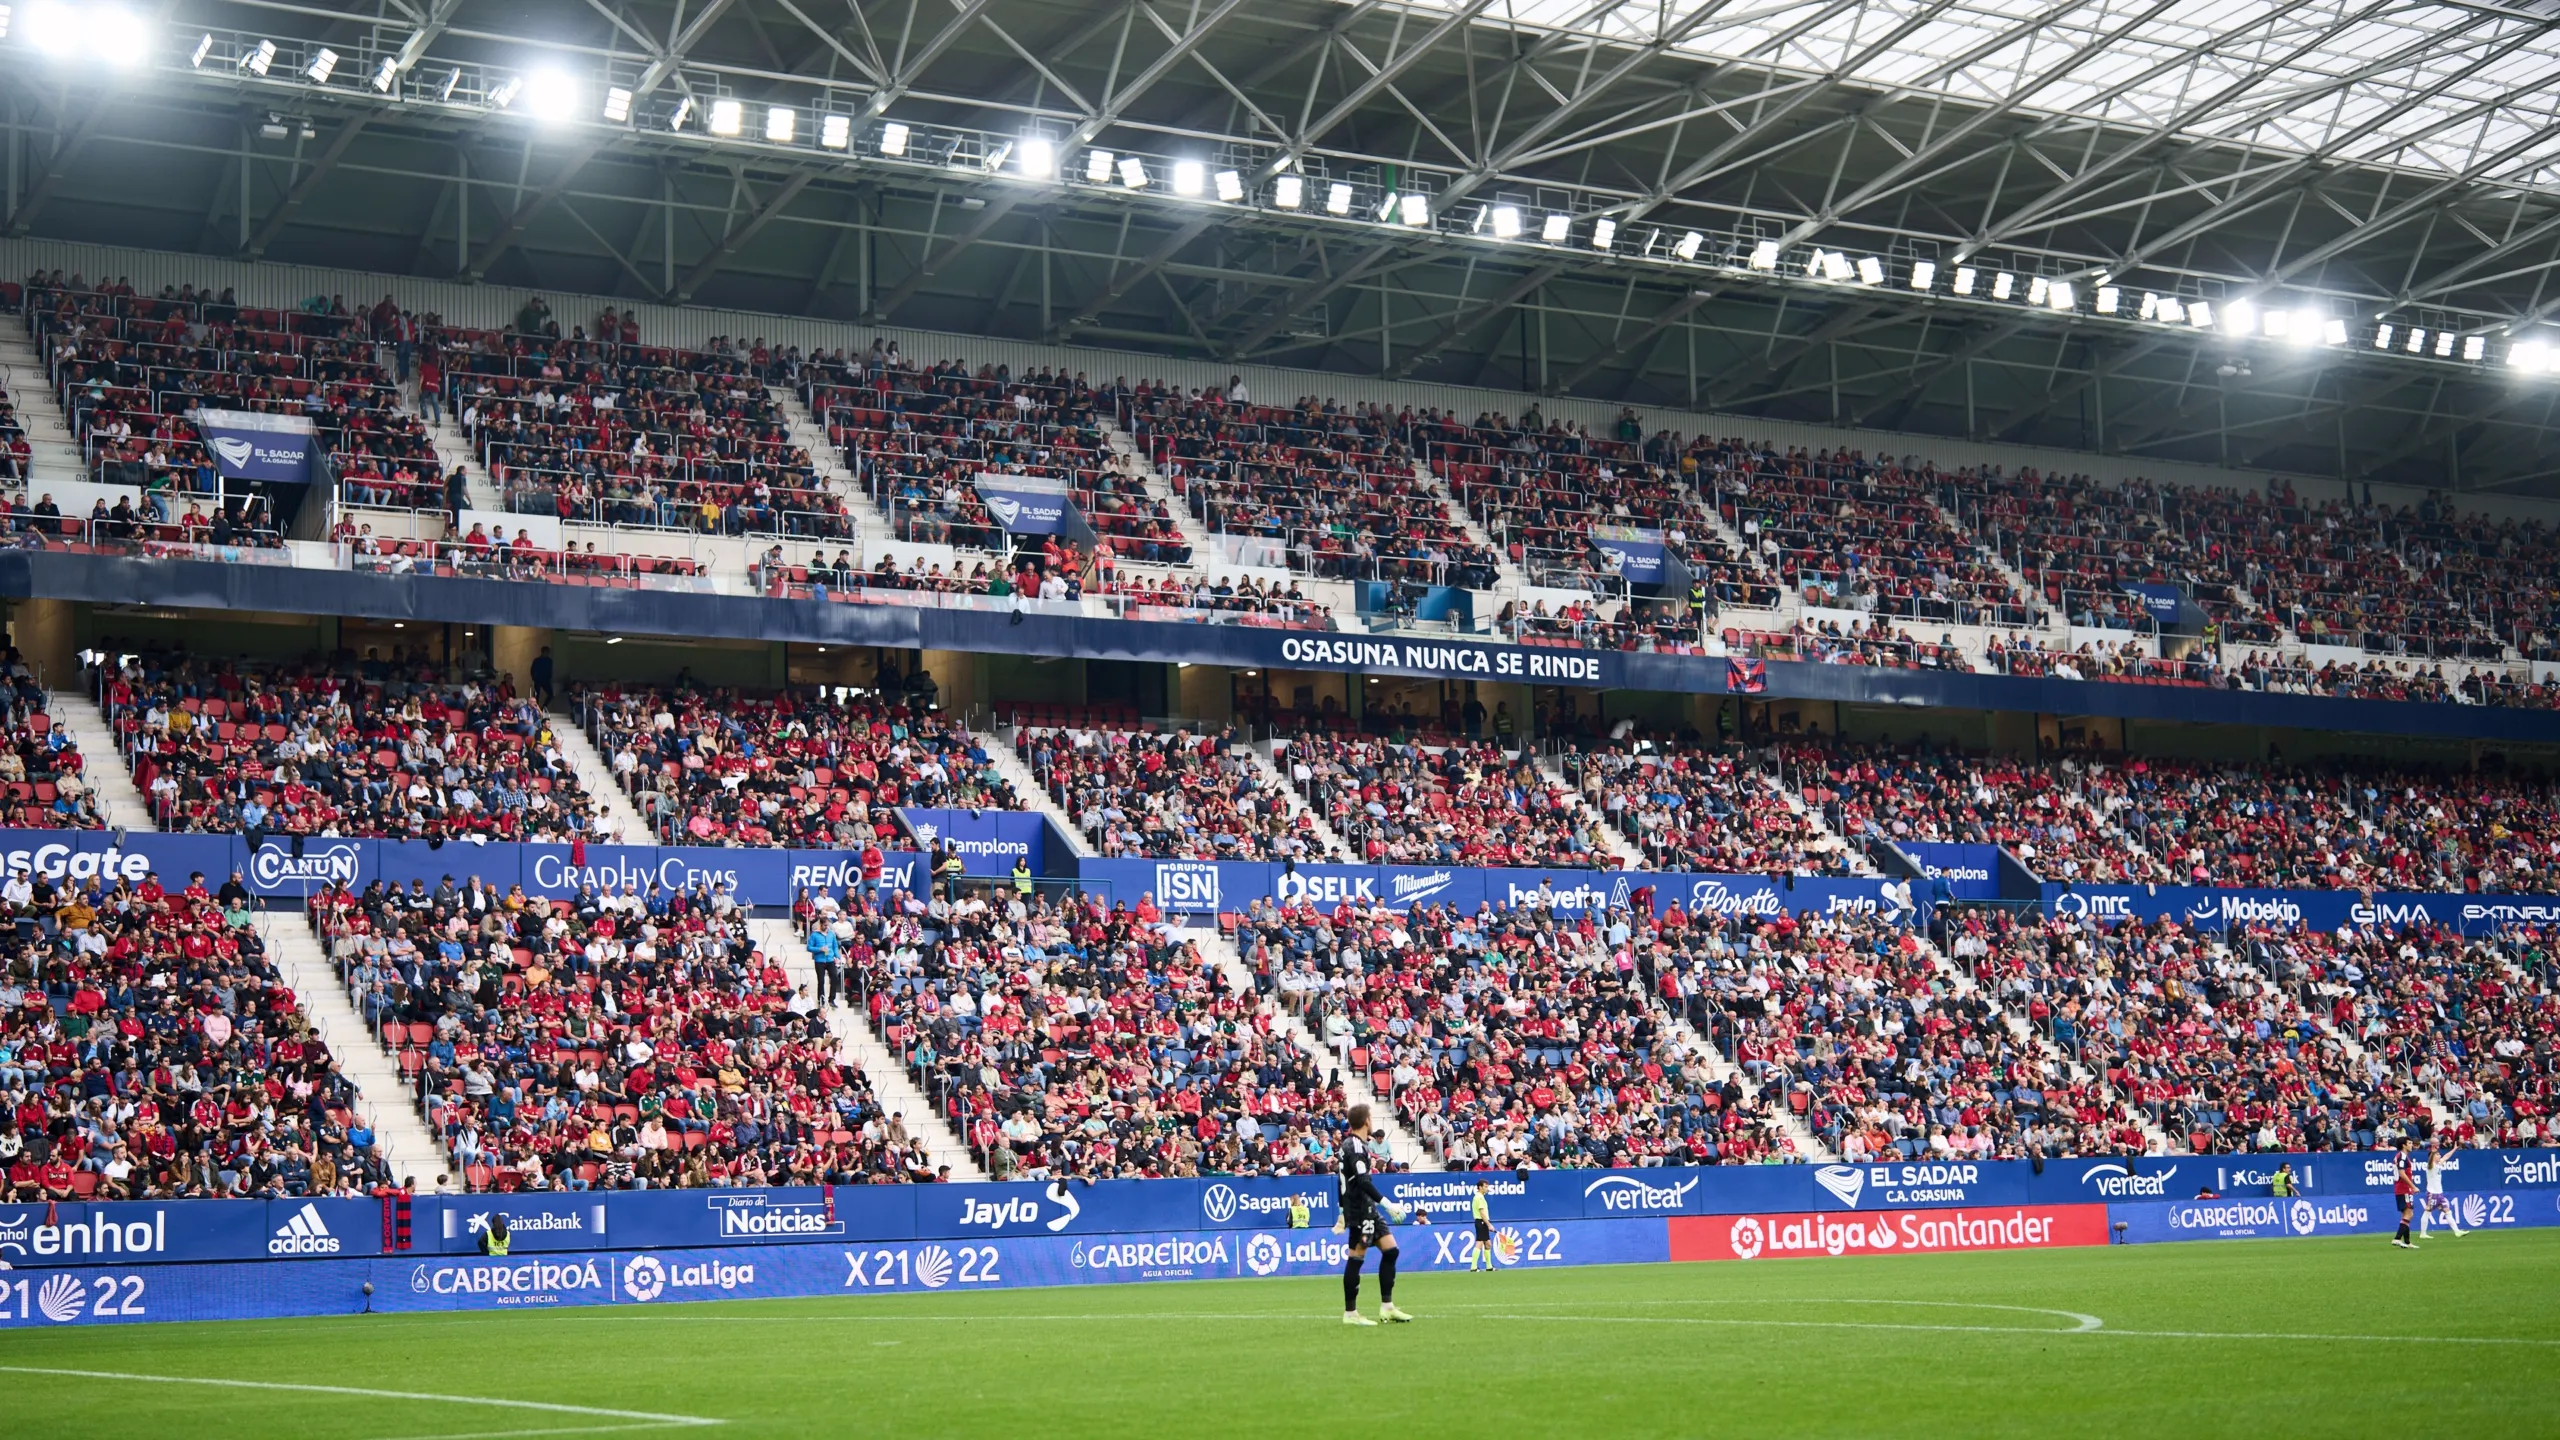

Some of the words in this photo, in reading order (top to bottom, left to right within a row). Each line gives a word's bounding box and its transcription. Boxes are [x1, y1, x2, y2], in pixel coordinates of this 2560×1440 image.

[53, 421, 65, 430] 05
[254, 448, 267, 458] EL
[269, 449, 305, 460] SADAR
[76, 473, 87, 482] 03
[1032, 507, 1062, 517] SADAR
[1636, 556, 1661, 566] SADAR
[2155, 597, 2175, 606] SADAR
[1282, 638, 1400, 667] OSASUNA
[1405, 645, 1491, 673] NUNCA
[1496, 653, 1524, 675] SE
[1529, 654, 1600, 680] RINDE
[944, 837, 1029, 857] Pamplona
[0, 843, 150, 881] sGate
[793, 859, 915, 888] RENOEN
[1169, 862, 1206, 872] GRUPO
[1163, 872, 1212, 900] ISN
[1391, 870, 1452, 897] Milwaukee
[1508, 882, 1606, 910] hevetia
[1689, 880, 1783, 916] Florette
[2090, 895, 2131, 914] mrc
[2221, 896, 2301, 926] Mobekip
[2350, 903, 2431, 924] GIMA
[1870, 1167, 1898, 1187] EL
[1901, 1164, 1978, 1186] SADAR
[2096, 1169, 2165, 1196] verleal
[2365, 1173, 2379, 1186] de
[728, 1196, 751, 1207] Diario
[752, 1196, 764, 1206] de
[1393, 1182, 1442, 1198] Clínica
[1601, 1181, 1684, 1210] verleal
[1885, 1190, 1908, 1203] C.A.
[1910, 1188, 1965, 1202] OSASUNA
[959, 1197, 1039, 1229] Jaylo
[1413, 1198, 1471, 1213] Navarra
[2317, 1203, 2368, 1227] LaLiga
[2488, 1195, 2516, 1223] 22
[32, 1210, 165, 1255] enhol
[726, 1208, 826, 1234] Noticias
[1361, 1219, 1375, 1234] 25
[1901, 1207, 2054, 1249] Santander
[2219, 1229, 2236, 1237] AGUA
[2236, 1228, 2257, 1236] OFICIAL
[268, 1234, 340, 1253] adidas
[1526, 1227, 1562, 1261] 22
[1768, 1214, 1866, 1256] LaLiga
[671, 1260, 754, 1290] LaLiga
[957, 1246, 1001, 1283] 22
[1142, 1270, 1163, 1278] AGUA
[1164, 1268, 1194, 1277] OFICIAL
[93, 1275, 146, 1316] 22
[496, 1296, 522, 1305] AGUA
[523, 1294, 559, 1304] OFICIAL
